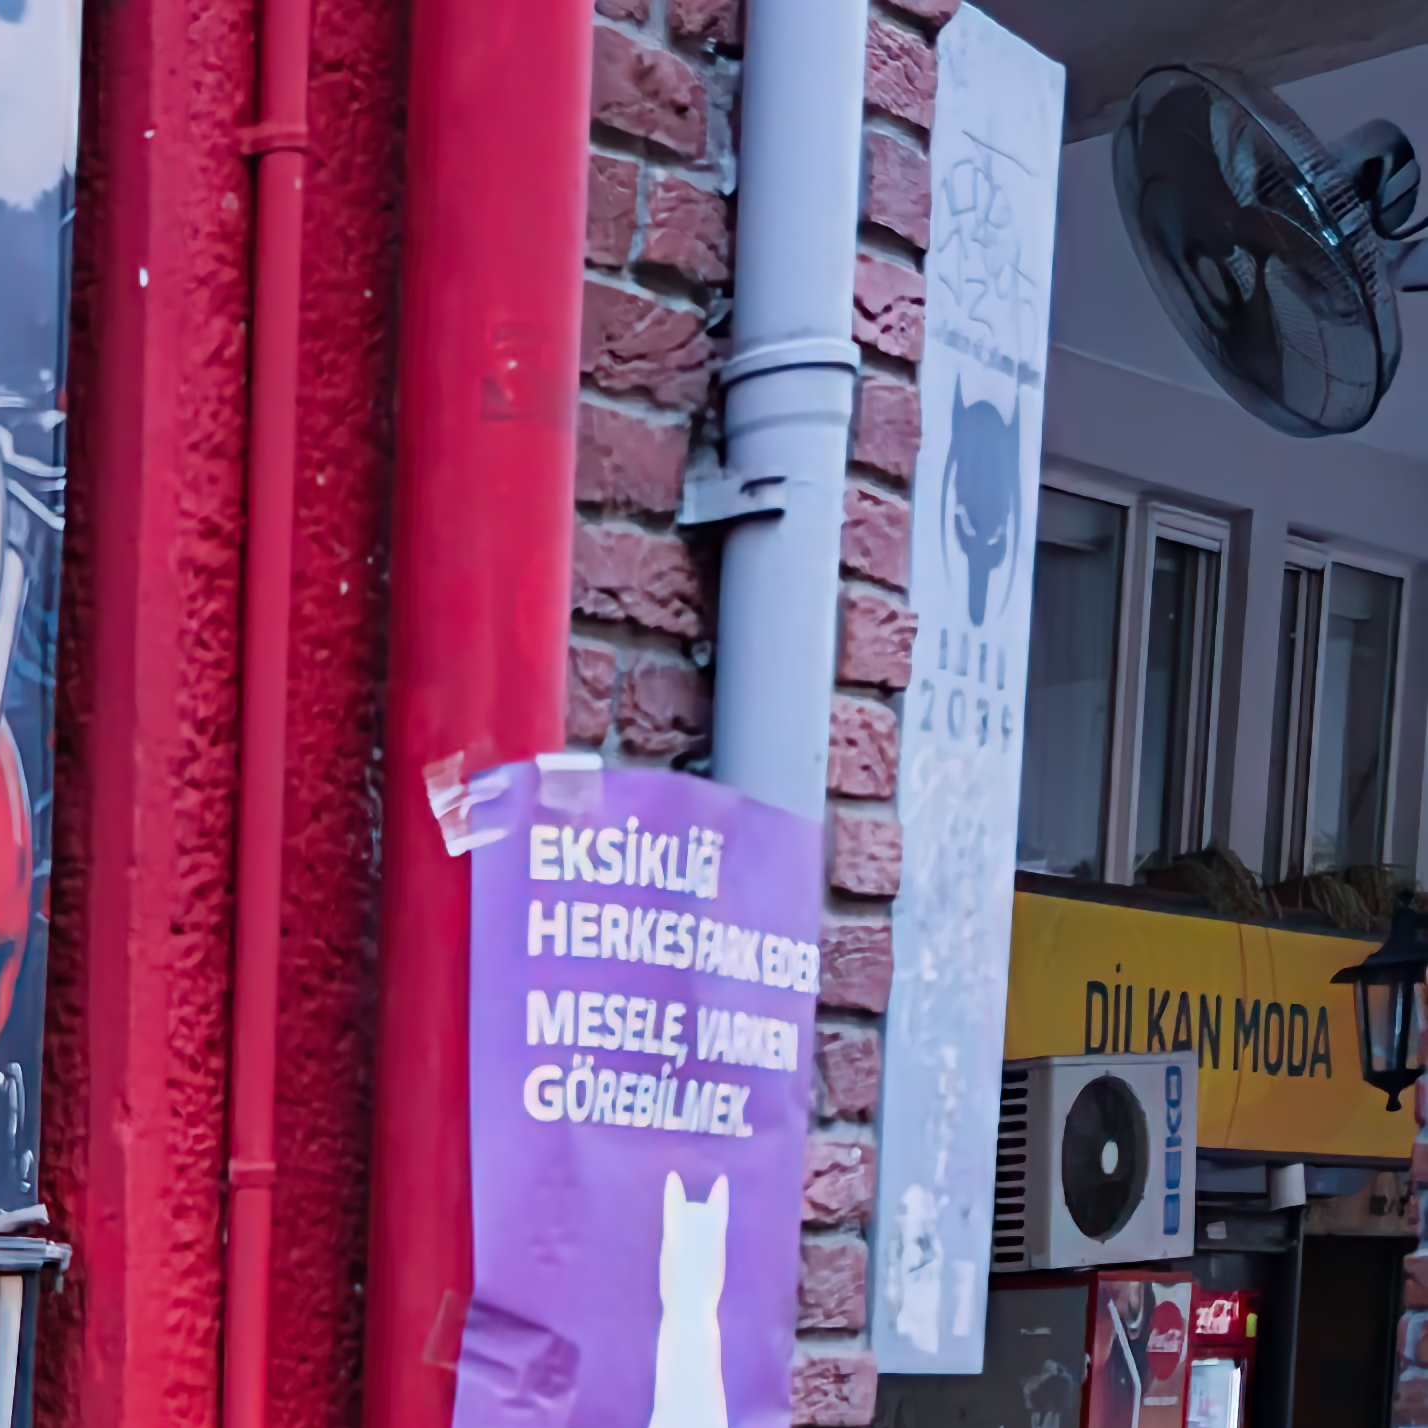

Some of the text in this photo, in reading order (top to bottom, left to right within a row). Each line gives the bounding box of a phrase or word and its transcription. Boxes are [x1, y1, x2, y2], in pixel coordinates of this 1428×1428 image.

[527, 900, 695, 969] HERKES
[526, 990, 688, 1068] MESELE,
[1233, 998, 1332, 1079] MODA
